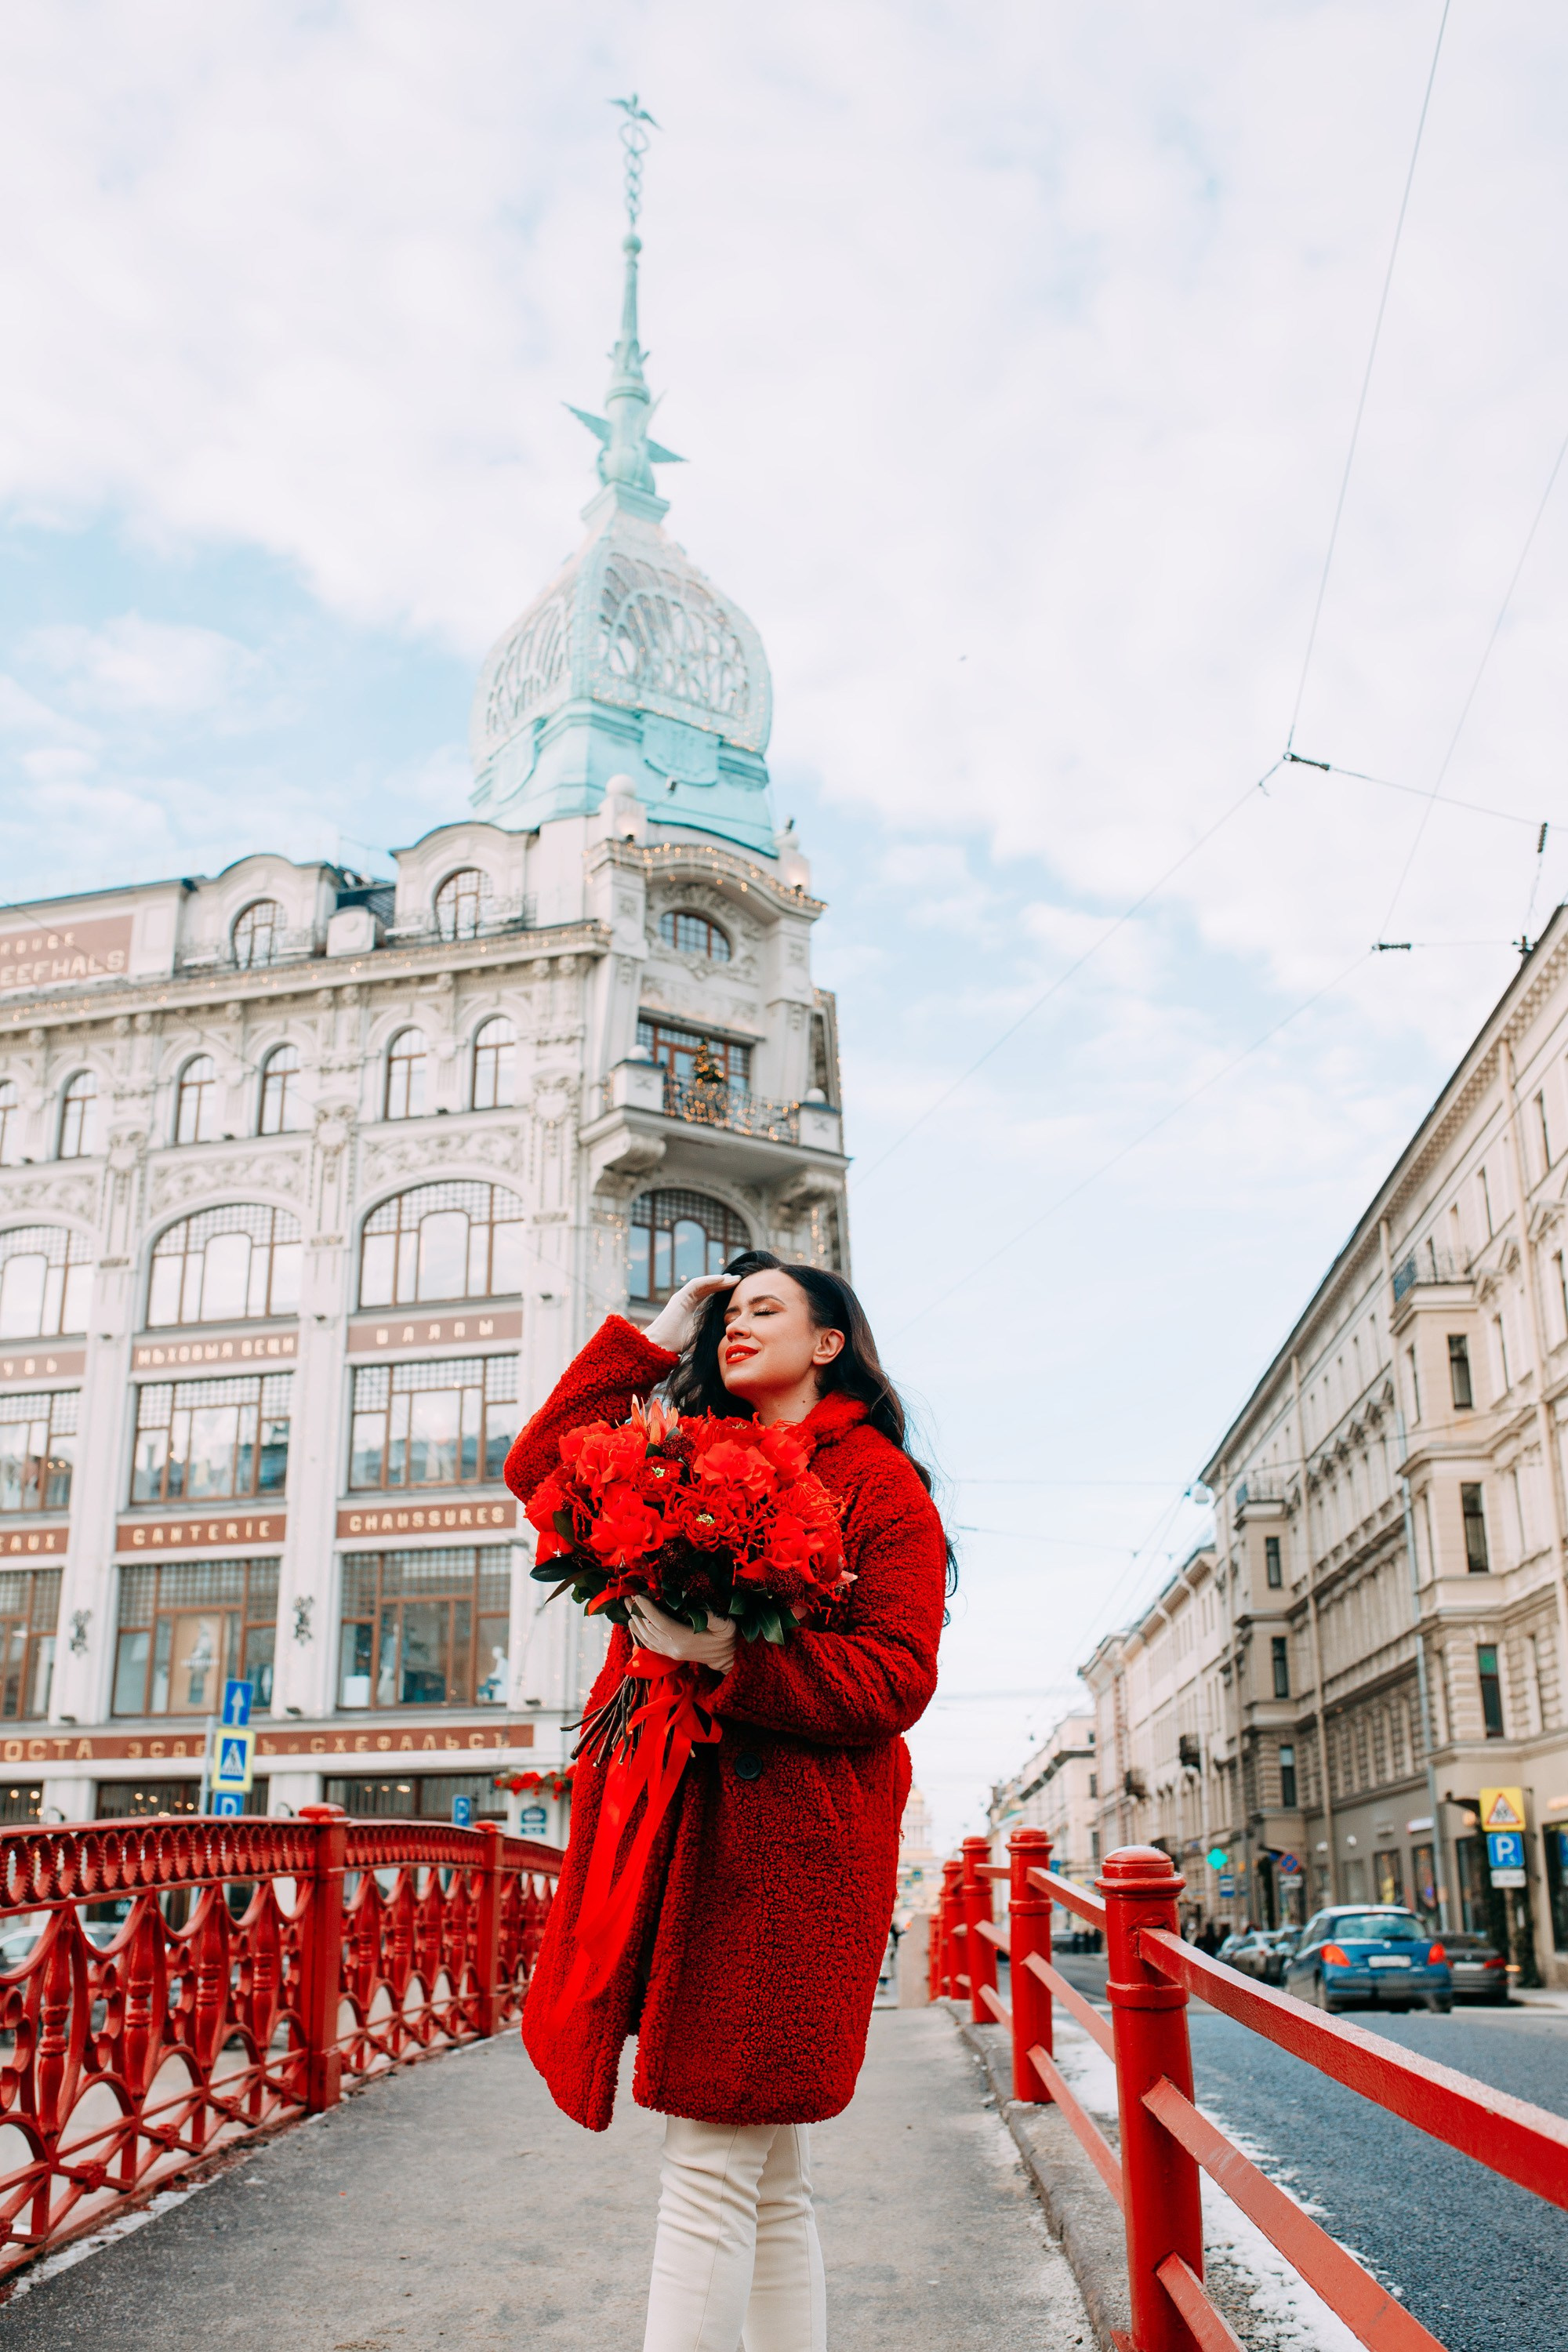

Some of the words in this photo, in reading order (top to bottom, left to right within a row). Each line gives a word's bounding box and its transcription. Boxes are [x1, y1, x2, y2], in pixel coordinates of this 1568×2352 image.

[350, 1506, 504, 1532] CHAUSSURES
[0, 1738, 93, 1762] ОСТА
[1496, 1836, 1514, 1863] P
